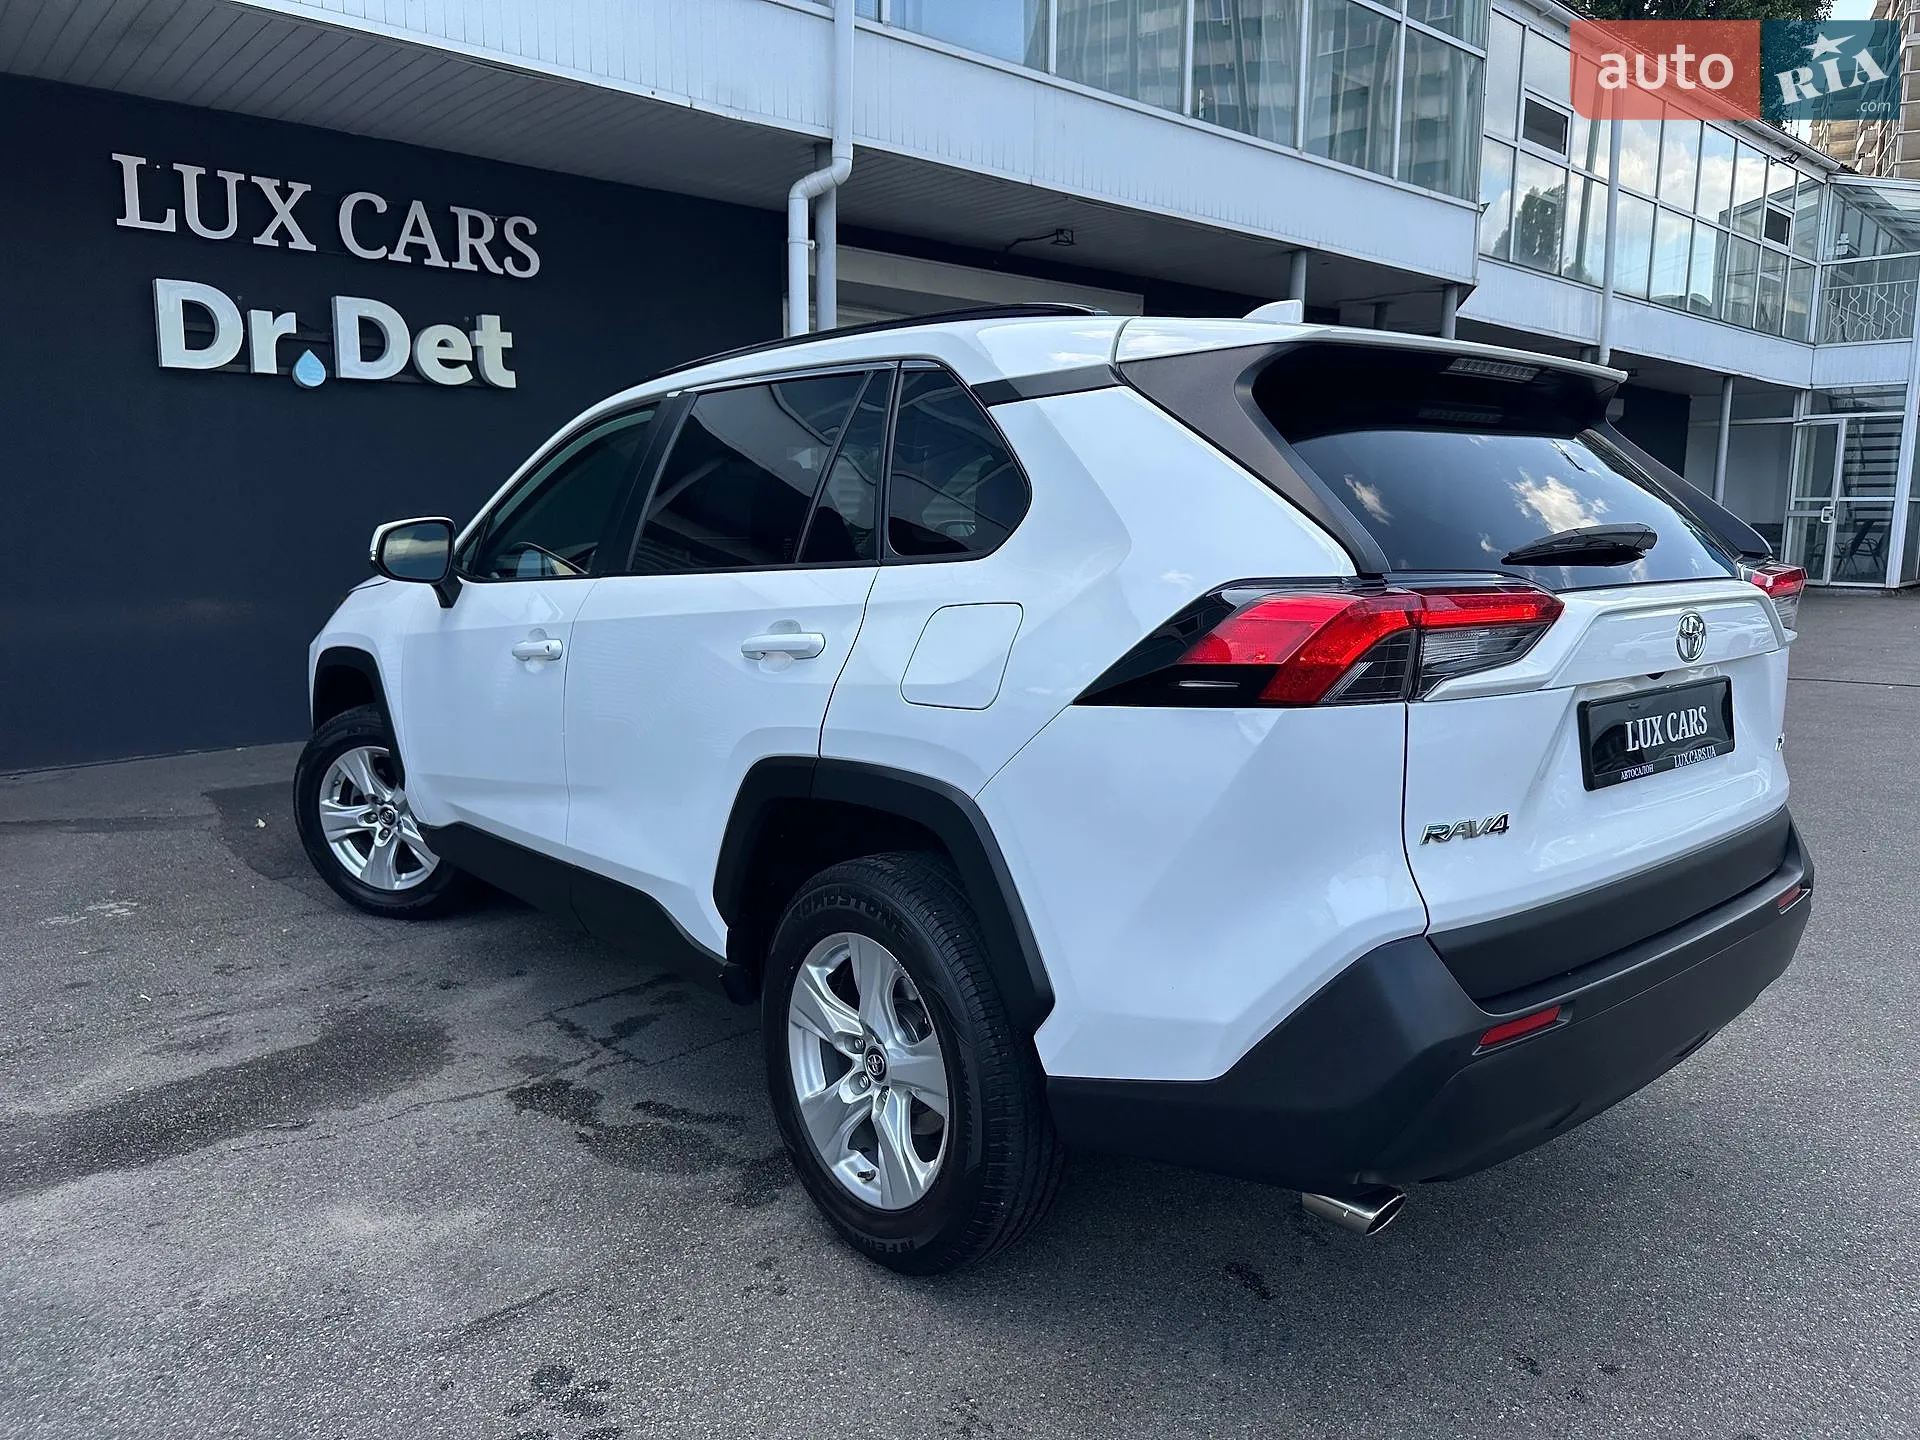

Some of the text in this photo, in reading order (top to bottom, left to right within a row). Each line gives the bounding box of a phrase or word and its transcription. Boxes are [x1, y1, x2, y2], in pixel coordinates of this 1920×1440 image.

[111, 152, 541, 279] LUX CARS
[1624, 705, 1708, 752] LUX CARS
[1420, 811, 1511, 846] RAV4
